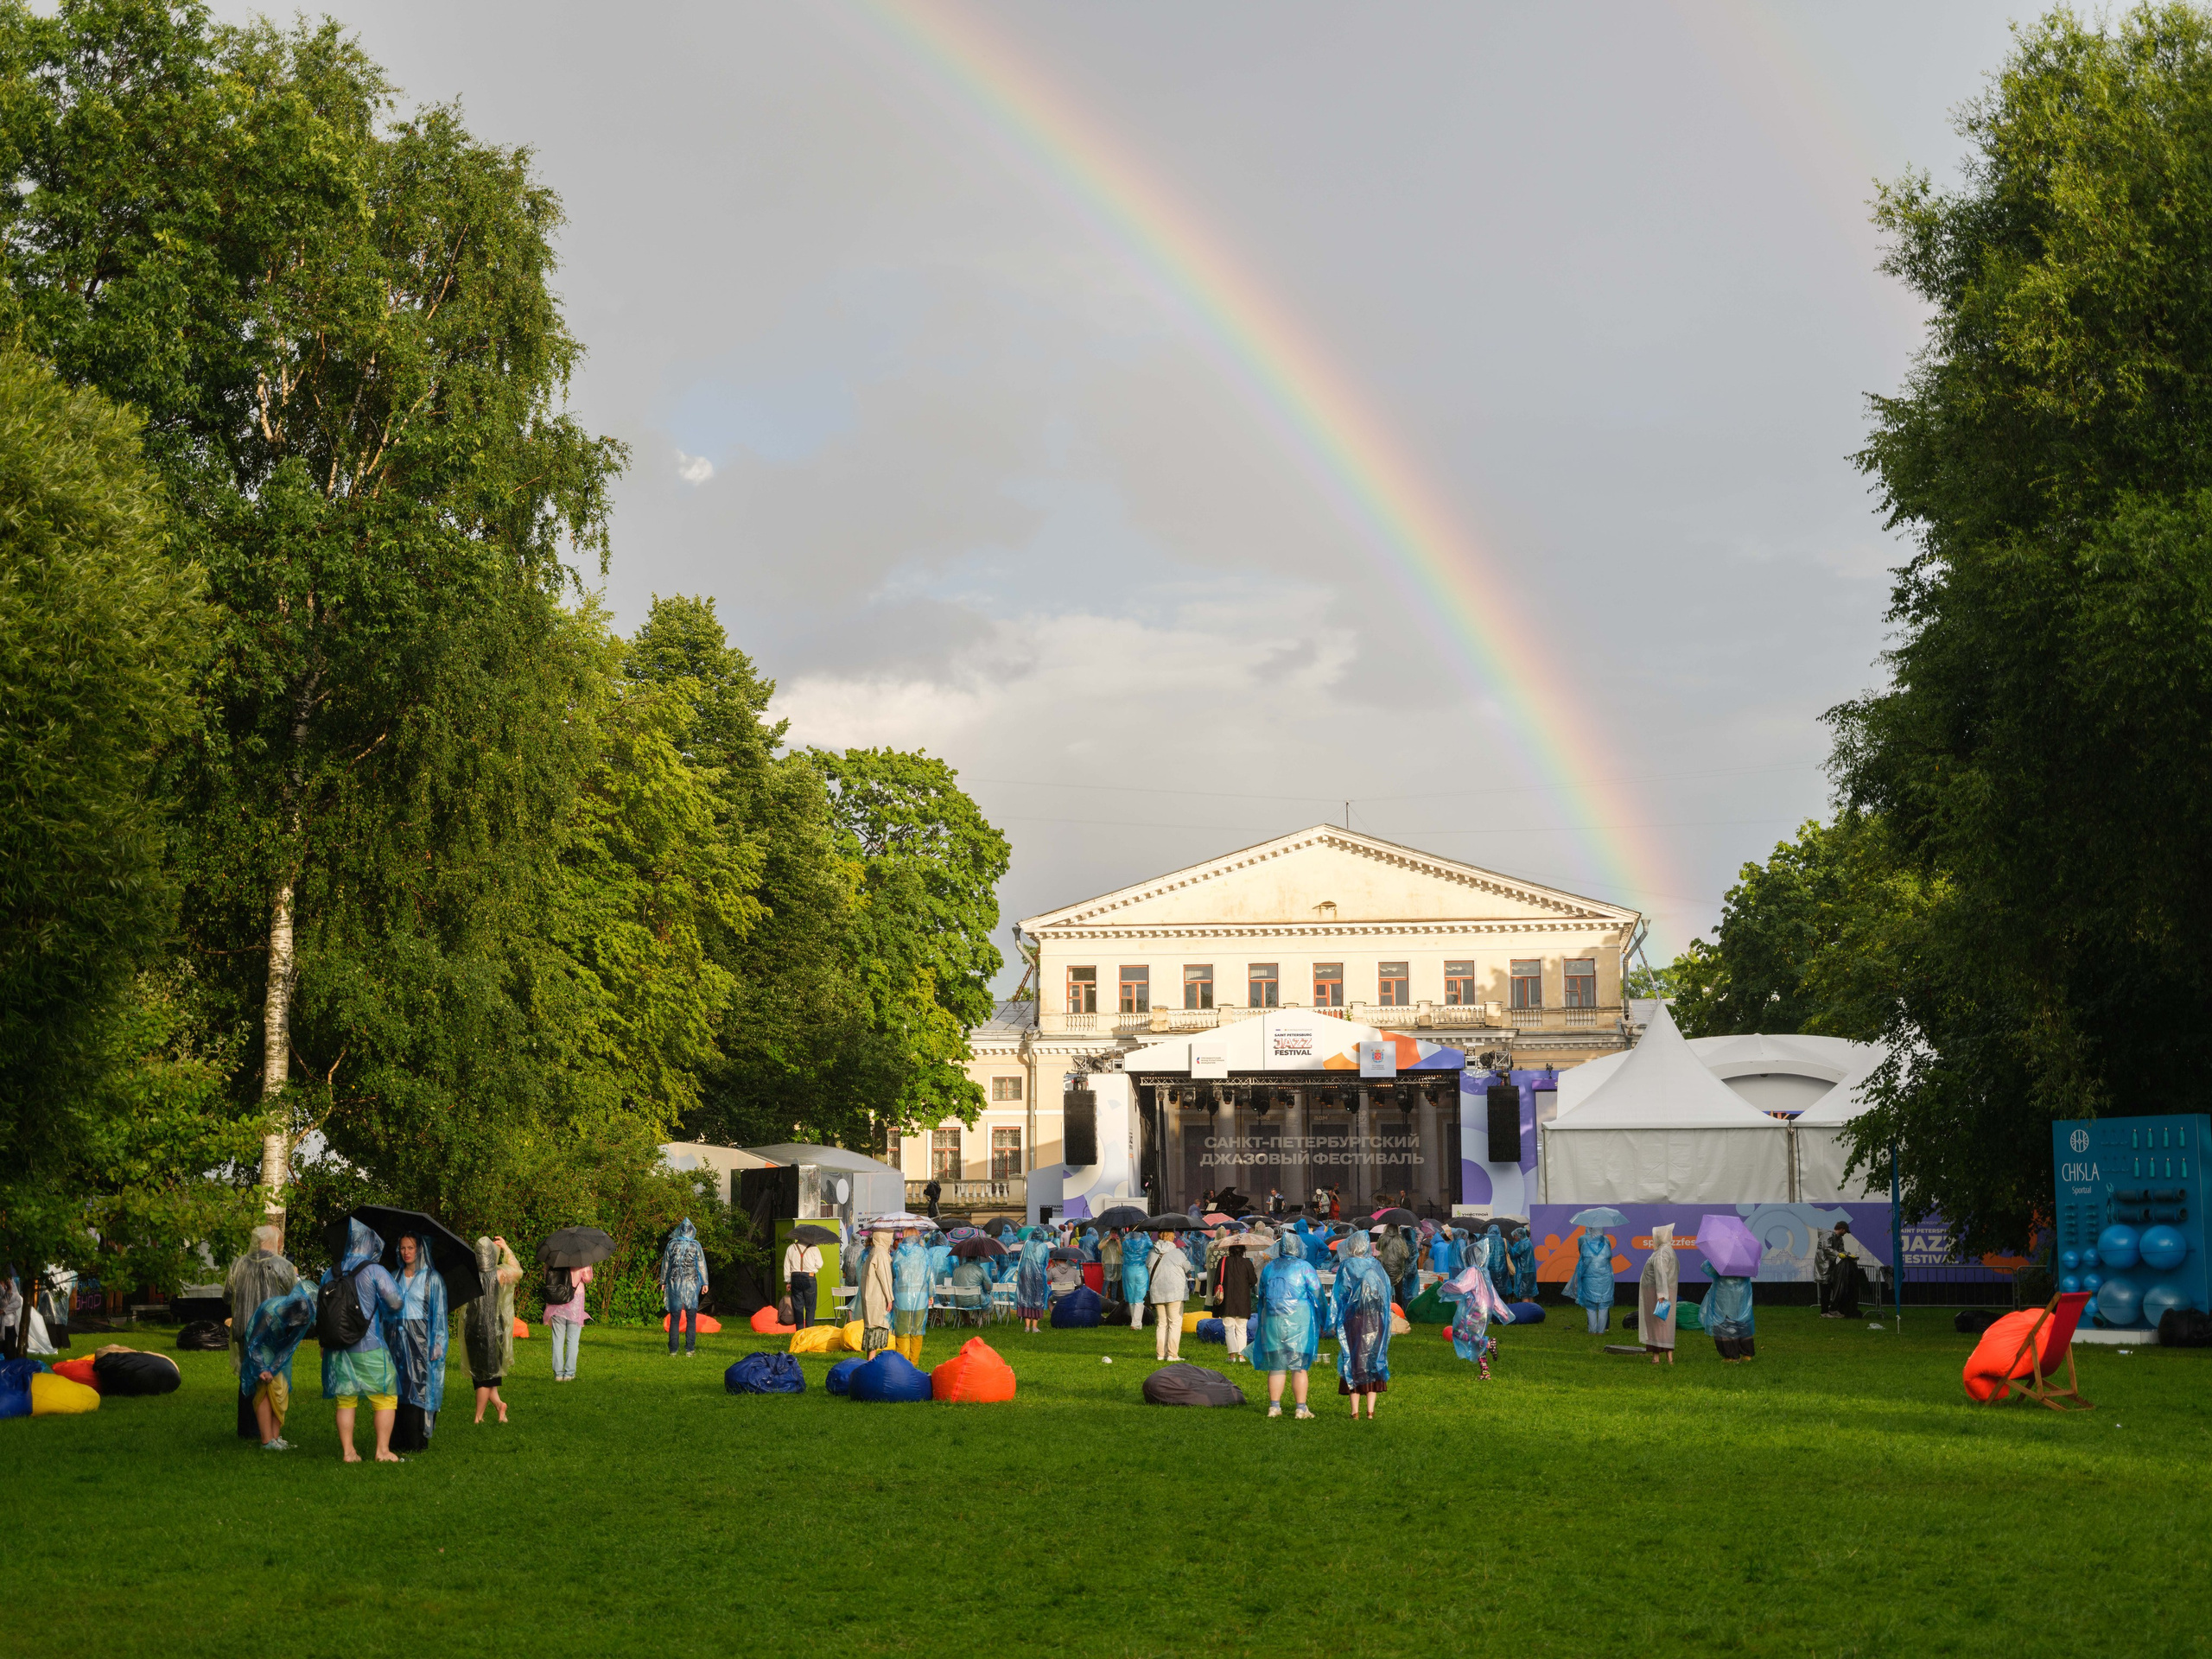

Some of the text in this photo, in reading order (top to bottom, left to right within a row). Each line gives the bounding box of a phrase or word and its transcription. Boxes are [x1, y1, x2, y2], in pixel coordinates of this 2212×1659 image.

[1274, 1038, 1312, 1049] JAZZ
[1204, 1133, 1420, 1148] САНКТ-ПЕТЕРБУРГСКИЙ
[1199, 1150, 1425, 1166] ДЖАЗОВЫЙ ФЕСТИВАЛЬ
[2062, 1162, 2100, 1181] CHISLA
[1903, 1255, 1959, 1264] ESTIVAL
